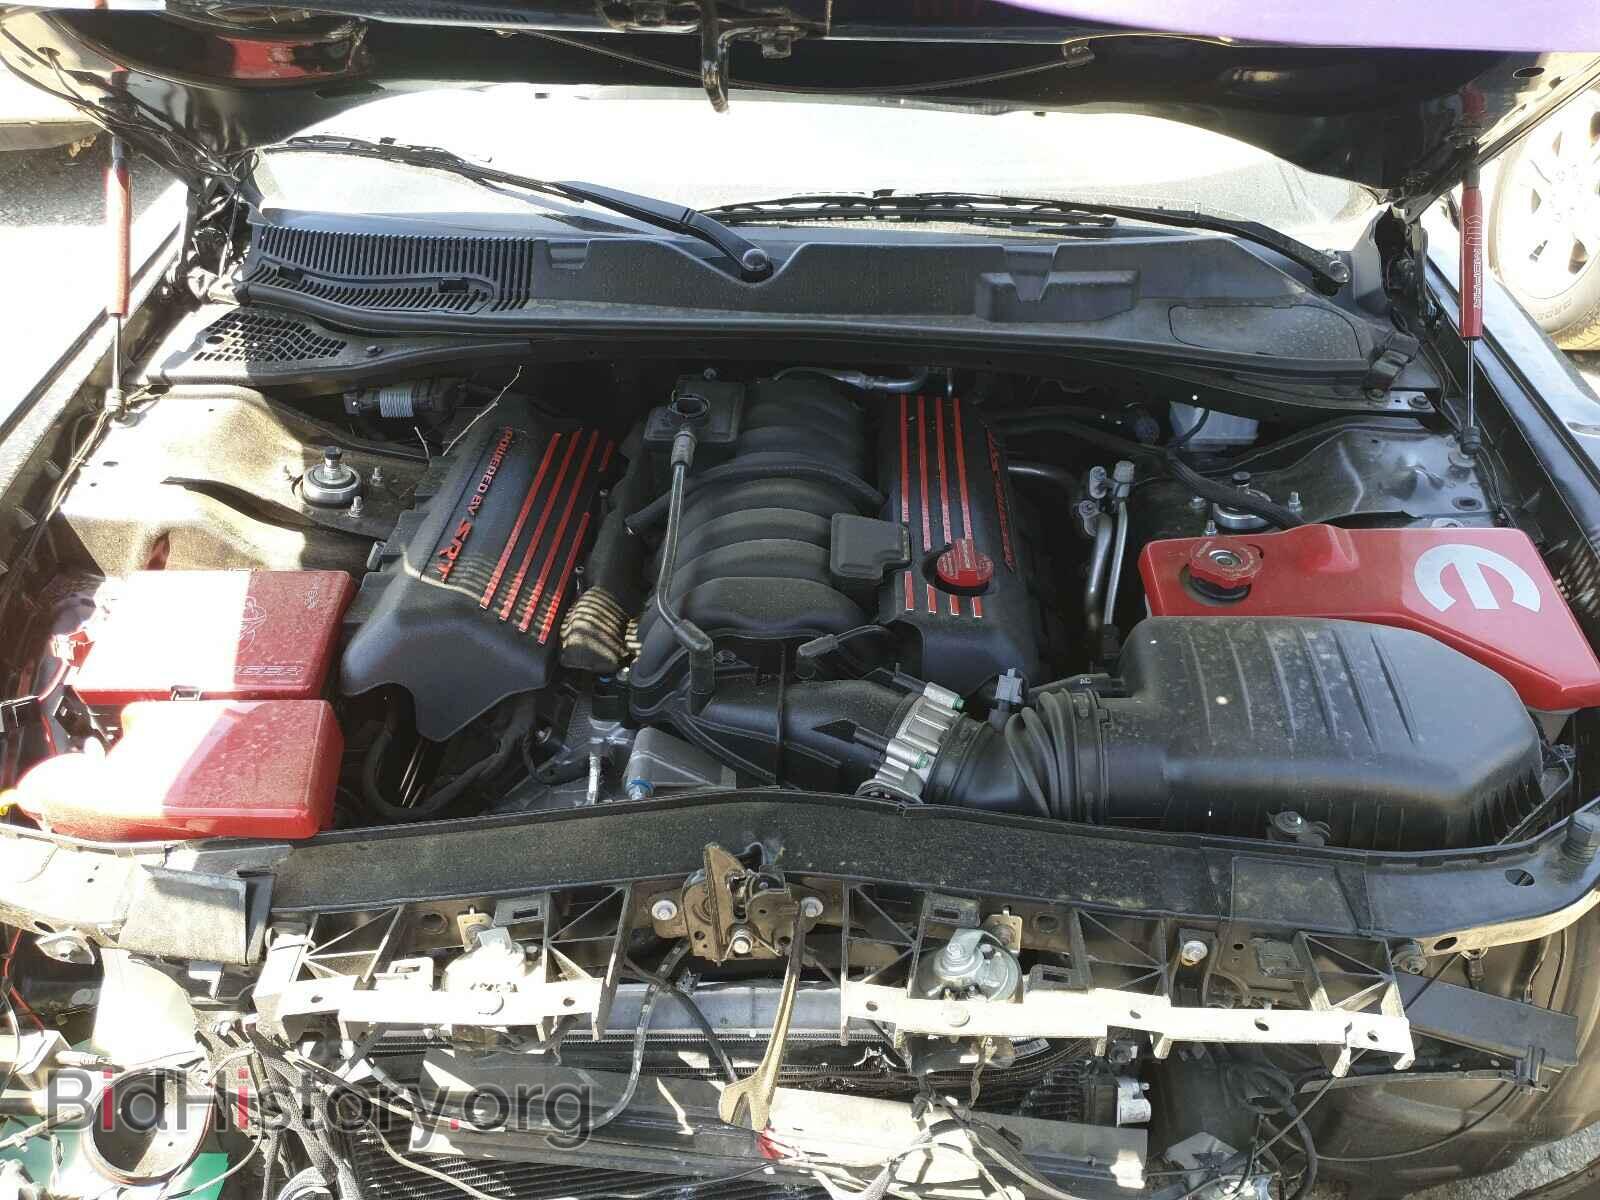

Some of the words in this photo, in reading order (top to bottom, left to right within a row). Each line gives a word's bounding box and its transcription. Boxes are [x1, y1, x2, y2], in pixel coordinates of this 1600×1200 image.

[478, 424, 513, 493] POWERED
[467, 494, 483, 516] BY
[436, 517, 474, 583] SRT
